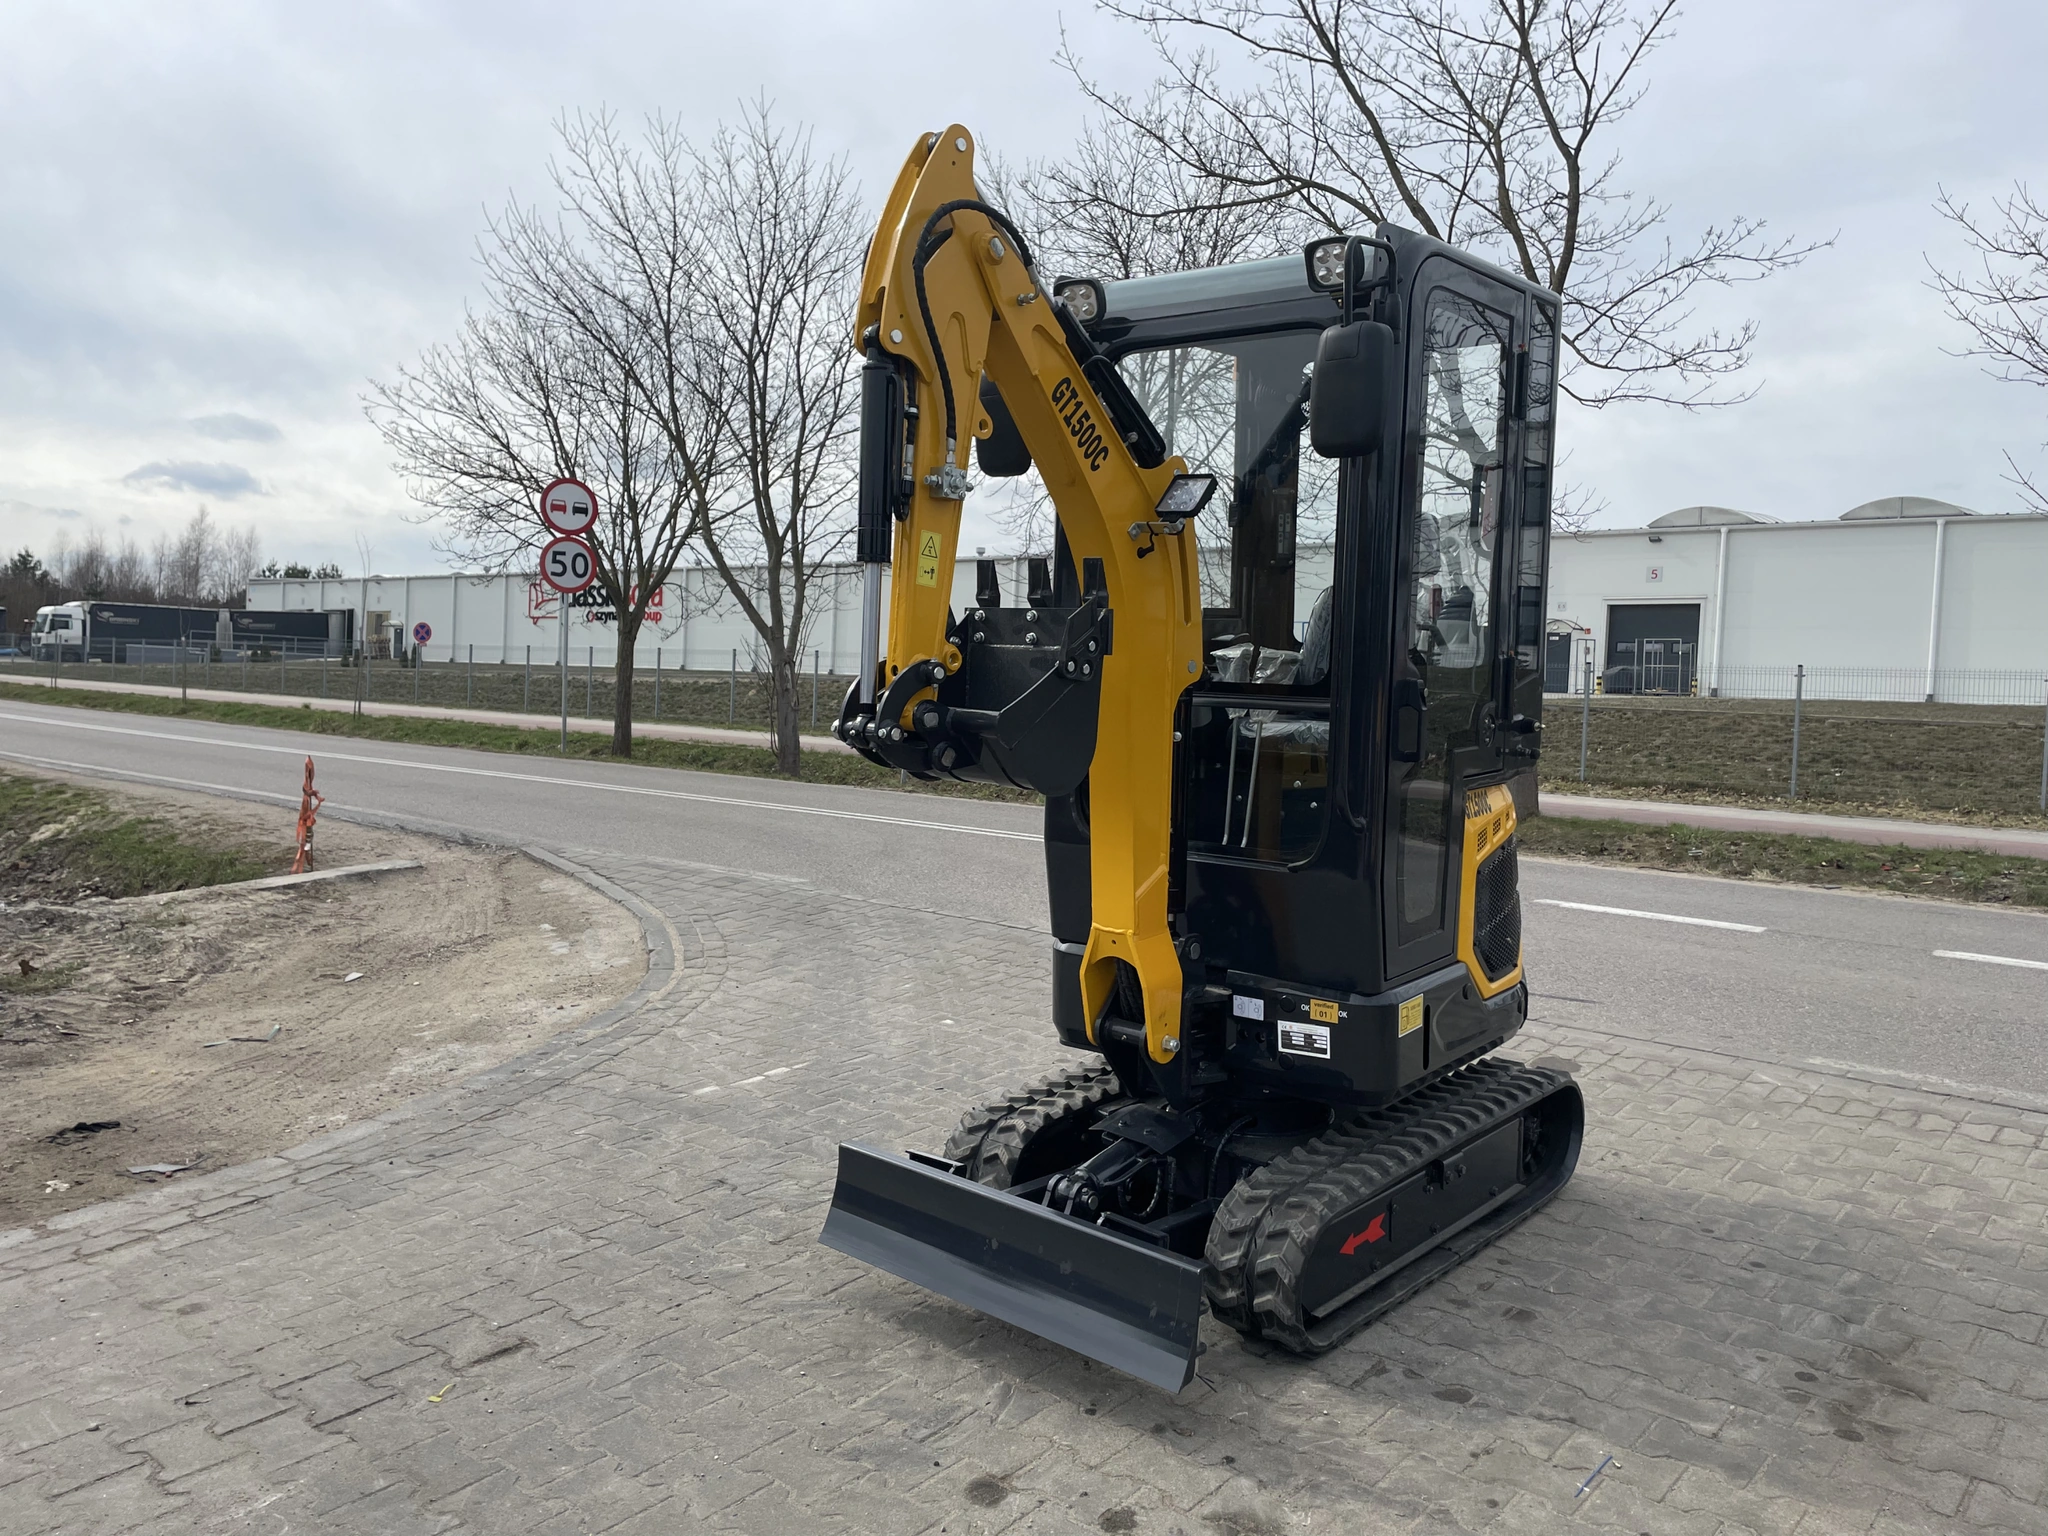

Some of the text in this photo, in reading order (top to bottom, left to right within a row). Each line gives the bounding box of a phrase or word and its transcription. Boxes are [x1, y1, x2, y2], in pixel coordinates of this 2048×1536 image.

[1052, 377, 1109, 472] GT1500C
[550, 551, 589, 578] 50
[1651, 569, 1658, 580] 5
[1314, 1002, 1334, 1010] verified
[1338, 1010, 1348, 1018] OK
